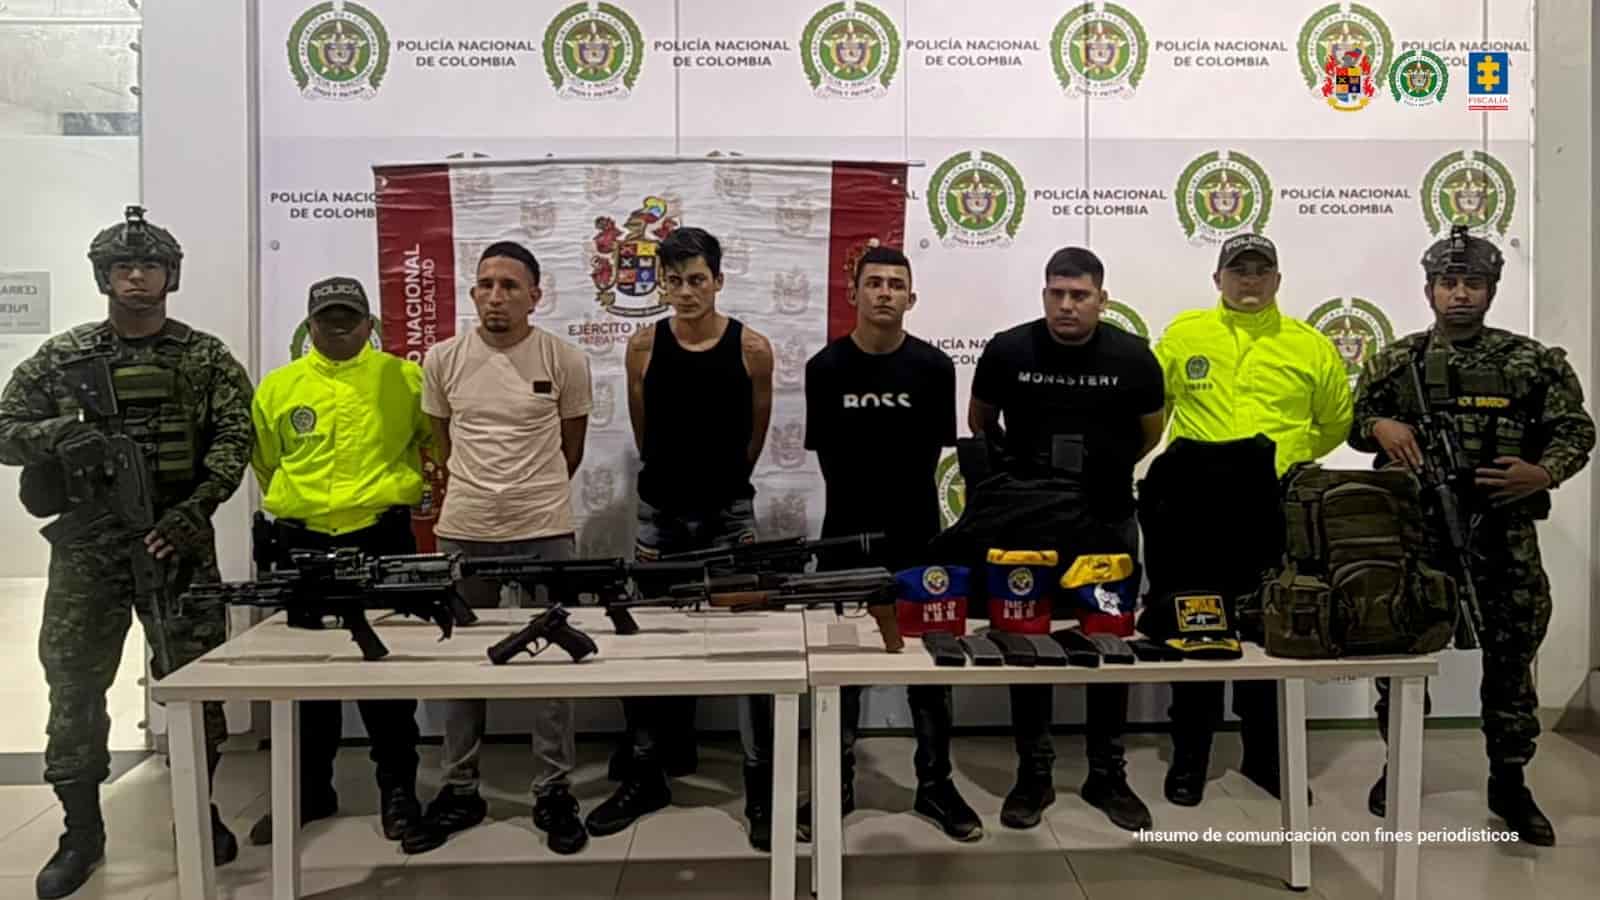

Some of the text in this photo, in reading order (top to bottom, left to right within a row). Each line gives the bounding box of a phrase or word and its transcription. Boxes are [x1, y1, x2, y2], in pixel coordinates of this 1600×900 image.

[397, 37, 536, 51] POLICÍA NACIONAL
[653, 37, 790, 51] POLICÍA NACIONAL
[906, 37, 1040, 51] POLICÍA NACIONAL
[1155, 37, 1288, 51] POLICÍA NACIONAL
[1401, 38, 1530, 51] POLICÍA NACIONAL
[415, 55, 516, 66] DE COLOMBIA
[672, 55, 772, 66] DE COLOMBIA
[924, 55, 1022, 66] DE COLOMBIA
[1173, 55, 1269, 66] DE COLOMBIA
[271, 189, 376, 203] POLICÍA NACIO
[1034, 187, 1167, 200] POLICÍA NACIONAL
[1280, 186, 1412, 199] POLICÍA NACIONAL
[290, 208, 375, 219] DE COLOMB
[1051, 204, 1149, 215] DE COLOMBIA
[1298, 203, 1394, 214] DE COLOMBIA
[404, 243, 422, 346] NACIONAL
[422, 258, 436, 321] LEALTAD
